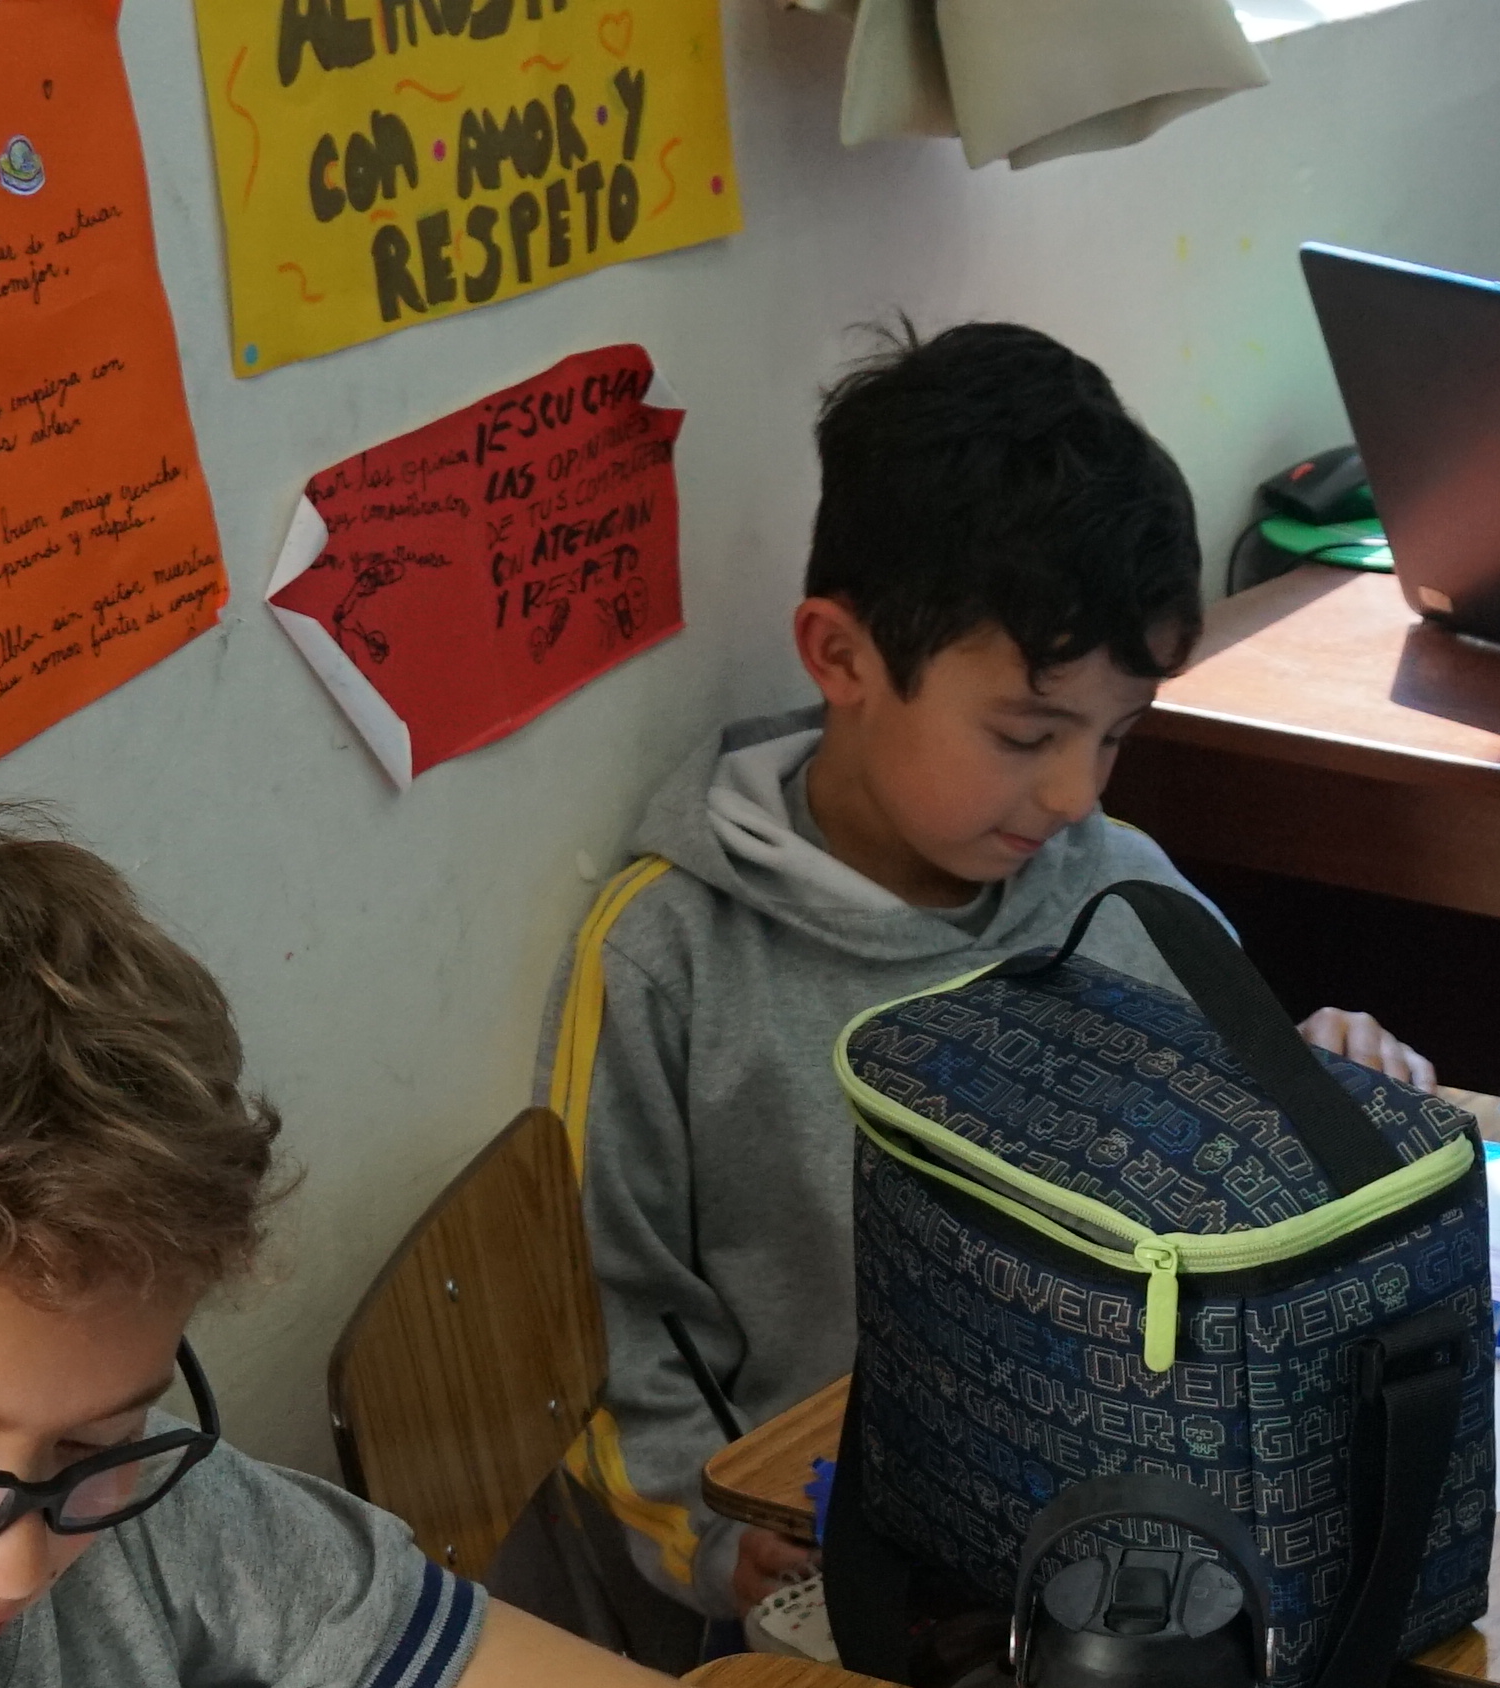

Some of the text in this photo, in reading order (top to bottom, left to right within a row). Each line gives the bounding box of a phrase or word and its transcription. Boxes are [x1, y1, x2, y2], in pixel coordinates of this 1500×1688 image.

[309, 65, 646, 223] CON AMOR Y
[370, 160, 640, 324] RESPETO
[984, 1248, 1132, 1344] OVER
[1245, 1276, 1373, 1353] VER
[1019, 1363, 1177, 1454] OVER
